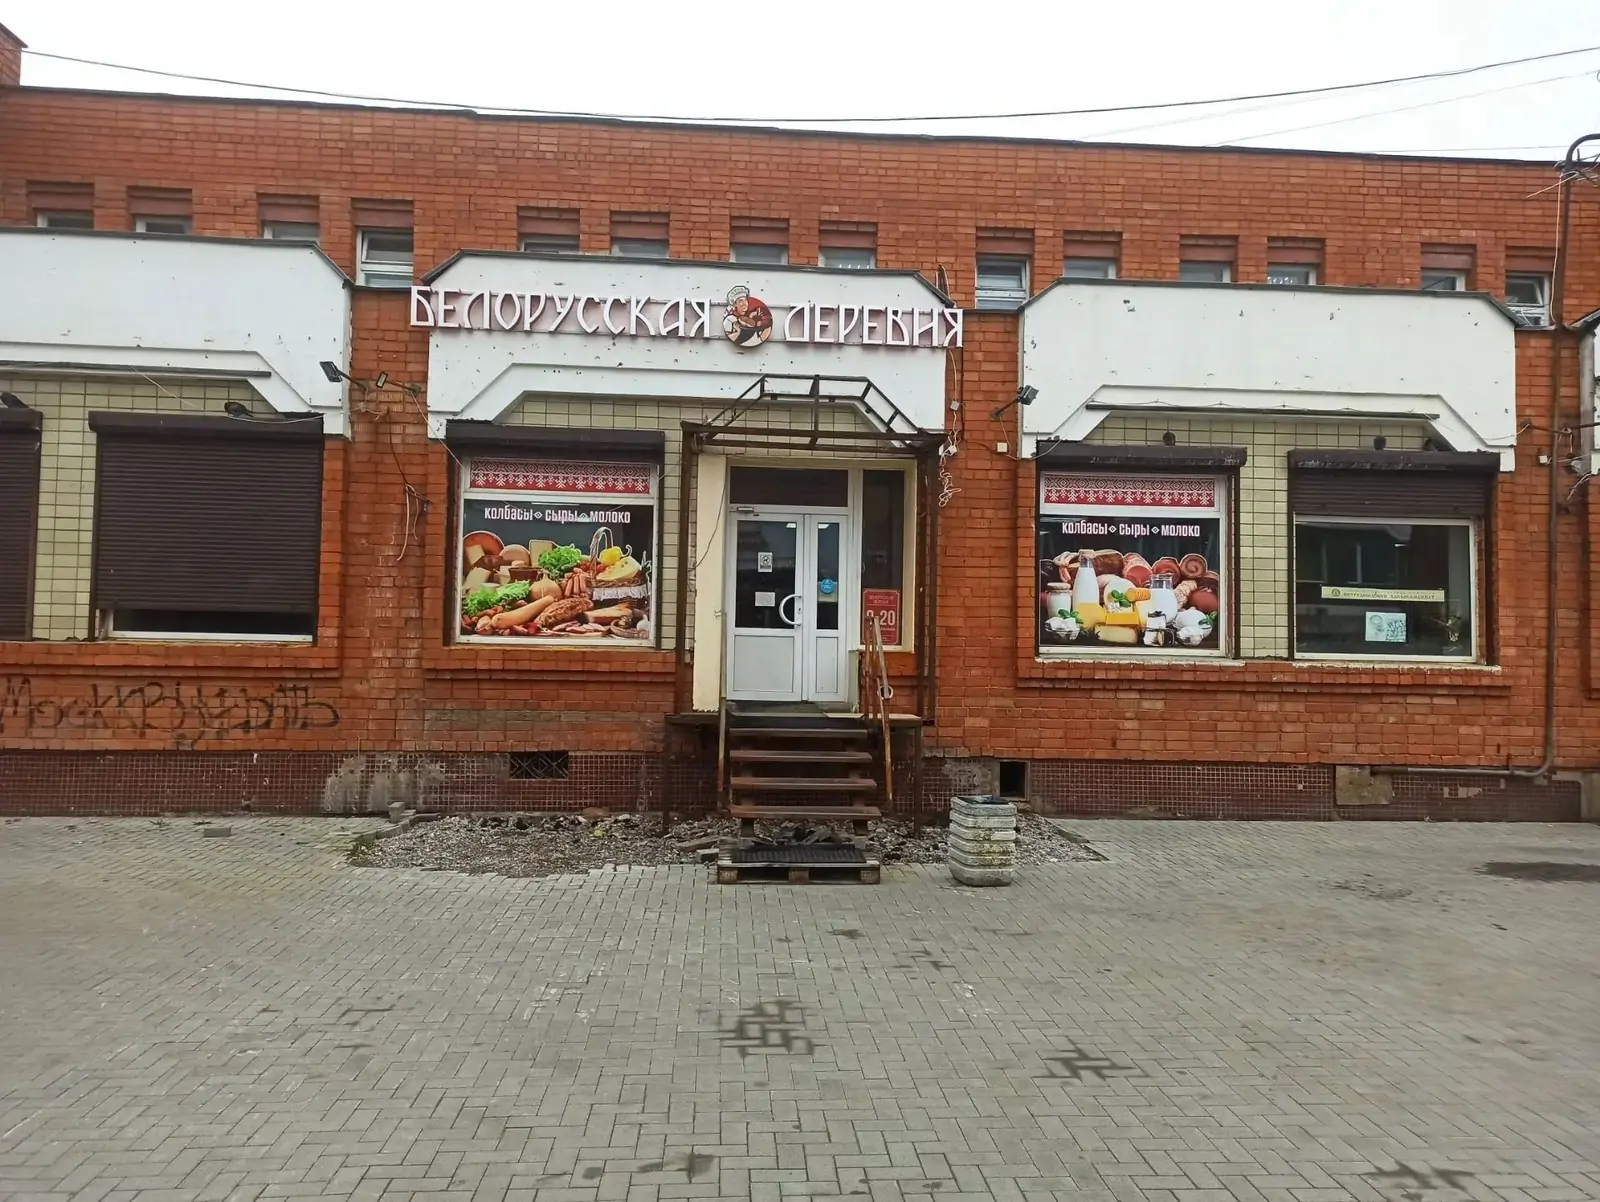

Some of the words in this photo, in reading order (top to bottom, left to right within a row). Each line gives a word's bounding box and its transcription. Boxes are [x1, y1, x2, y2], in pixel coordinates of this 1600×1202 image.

[409, 285, 712, 338] БЕЛОРУССКАЯ
[783, 303, 964, 348] ДЕРЕВНЯ
[484, 505, 533, 521] колбасы
[545, 509, 578, 524] сыры
[589, 509, 631, 523] молоко
[1062, 520, 1108, 535] колбасы
[1119, 523, 1150, 538] сыры
[1161, 524, 1200, 537] молоко
